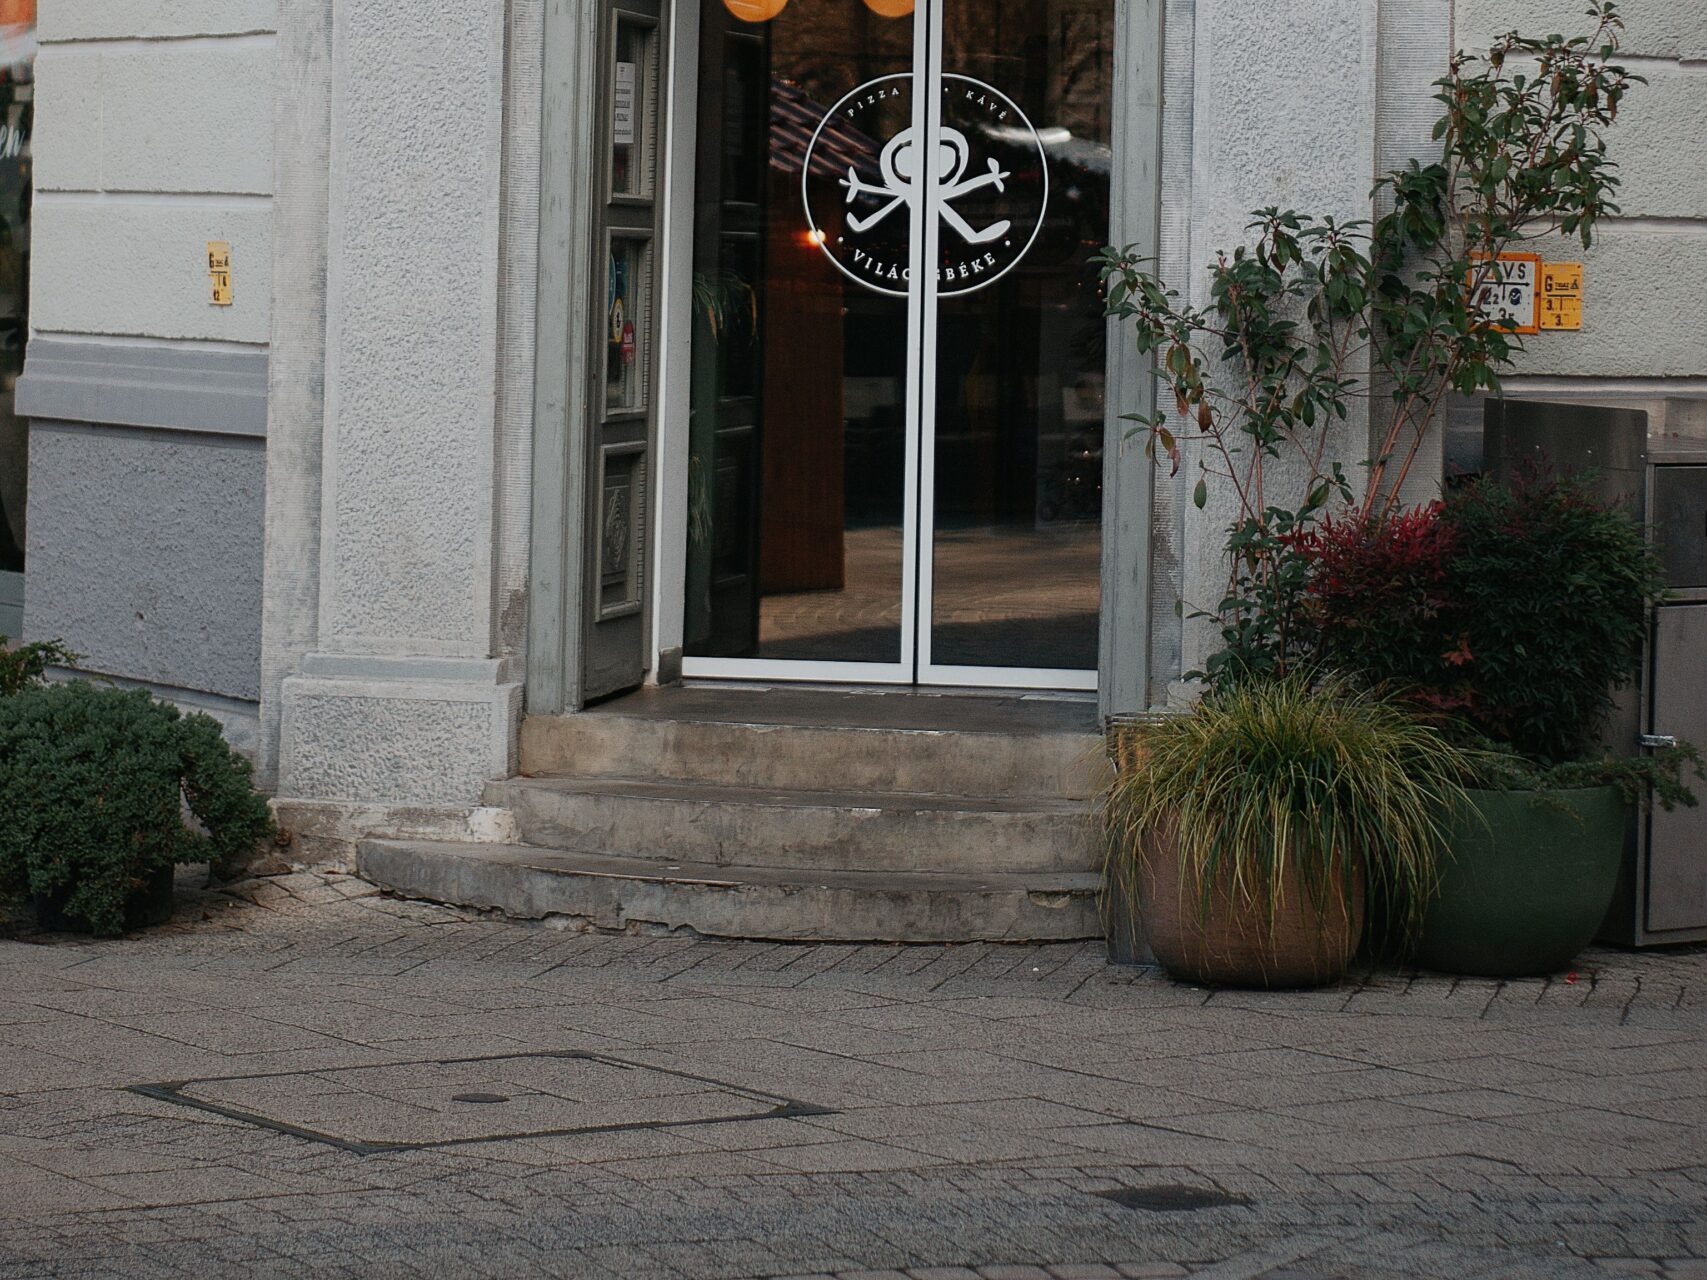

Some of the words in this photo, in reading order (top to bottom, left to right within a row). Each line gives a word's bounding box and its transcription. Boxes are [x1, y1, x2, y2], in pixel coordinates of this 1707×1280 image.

[847, 86, 900, 118] PIZZA
[965, 89, 1008, 120] KÁVÉ
[1545, 275, 1553, 293] G
